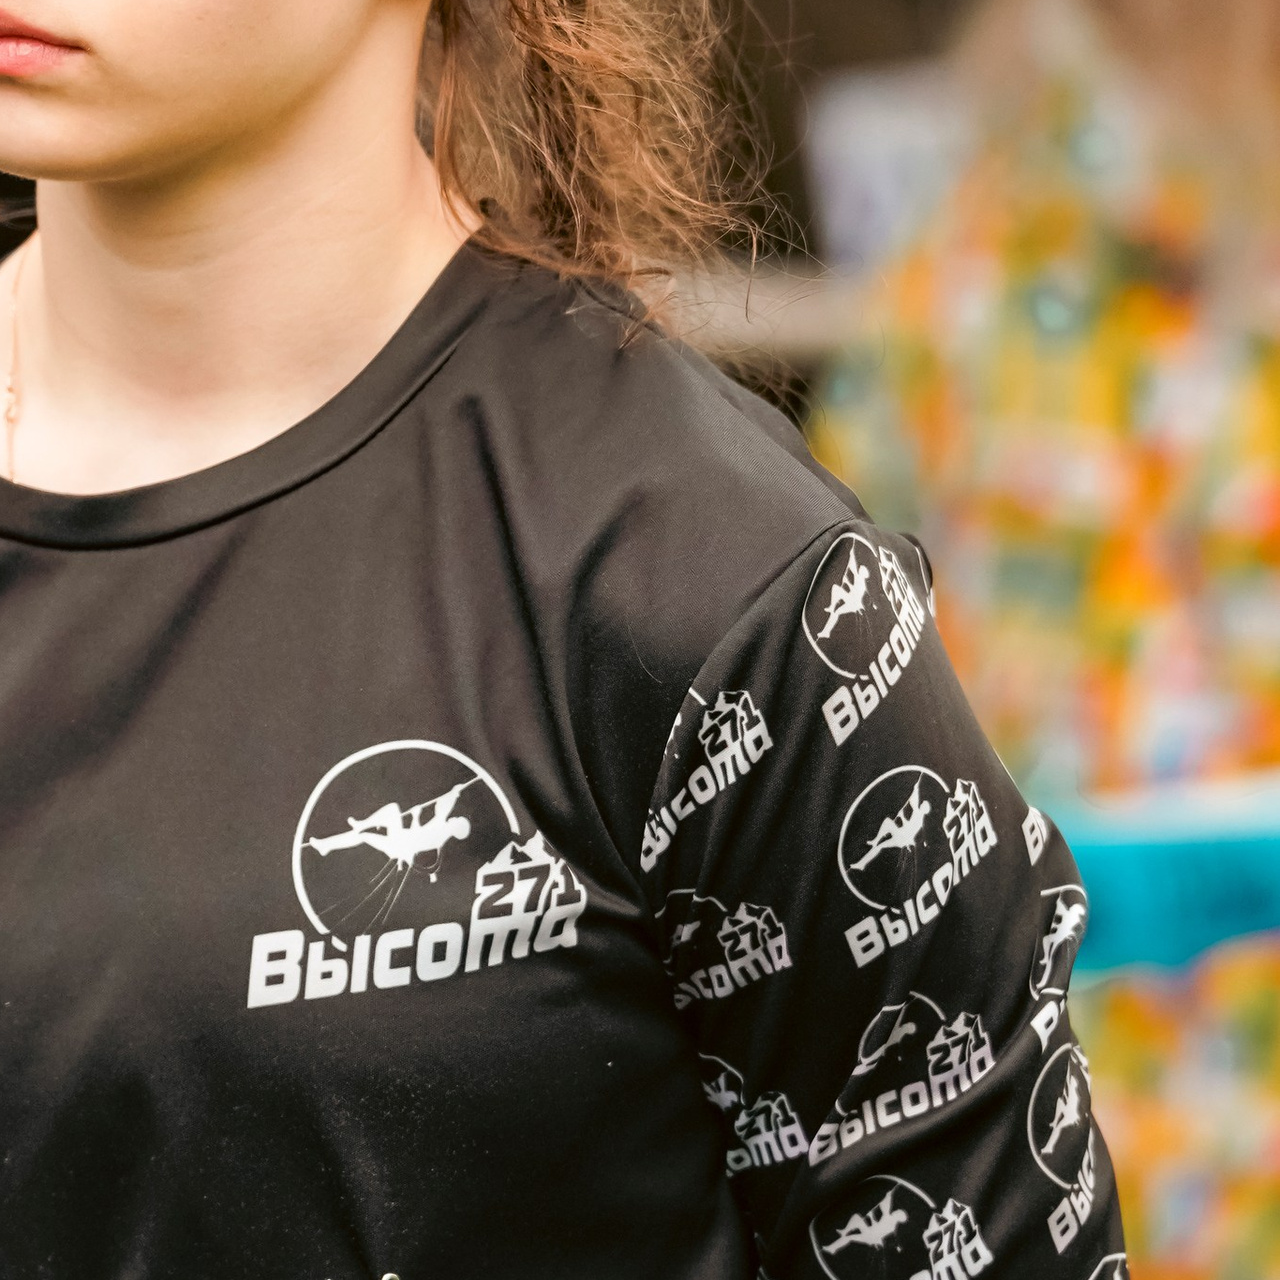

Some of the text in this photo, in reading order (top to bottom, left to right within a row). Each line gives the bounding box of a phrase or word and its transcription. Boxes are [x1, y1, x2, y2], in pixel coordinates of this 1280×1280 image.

[701, 696, 761, 758] 271
[477, 859, 582, 921] 271
[844, 809, 999, 969] Высота
[247, 907, 584, 1009] Высота
[719, 912, 784, 962] 271
[928, 1019, 987, 1077] 271
[927, 1207, 978, 1262] 271
